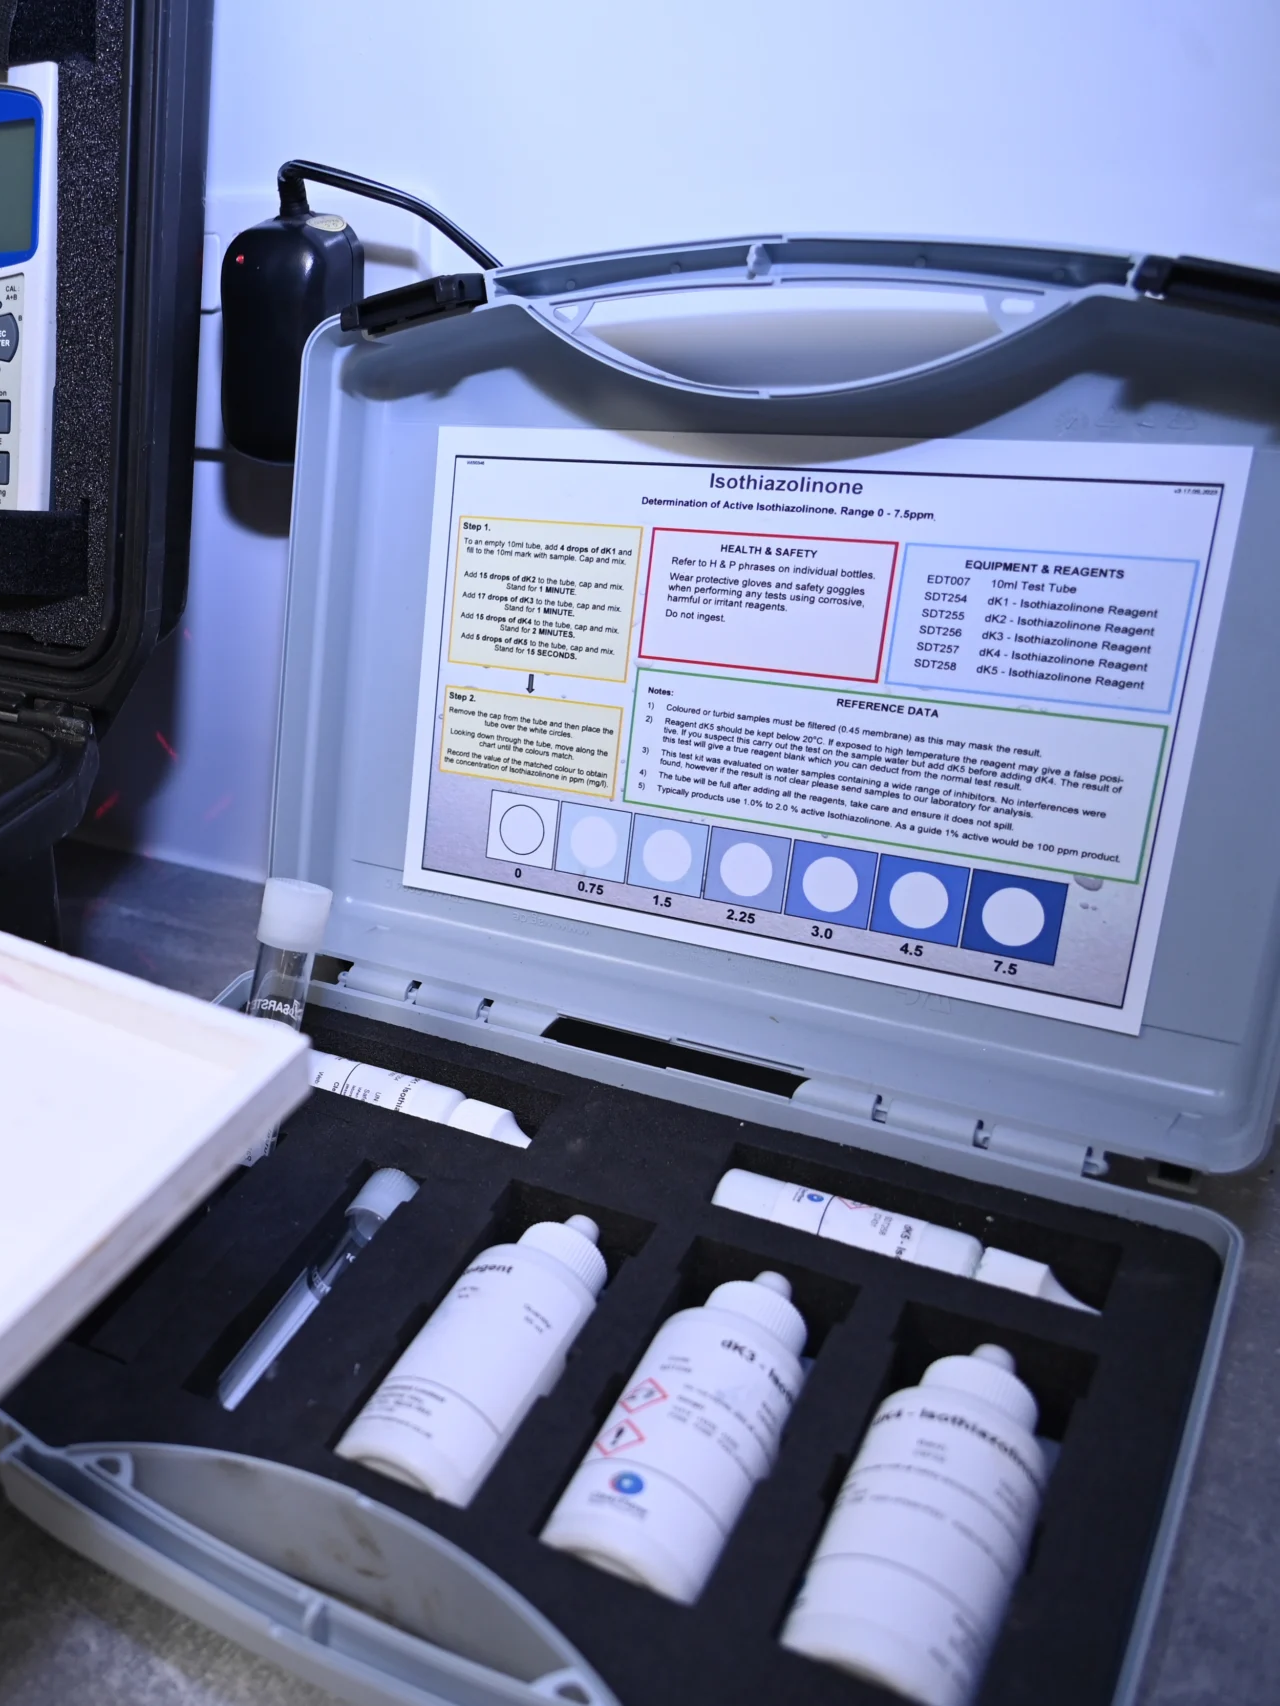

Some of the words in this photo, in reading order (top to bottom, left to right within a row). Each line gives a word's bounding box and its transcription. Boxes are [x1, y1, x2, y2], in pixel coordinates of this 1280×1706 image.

[709, 472, 863, 495] Isothiazolinone
[641, 496, 708, 508] Determination
[710, 499, 721, 508] of
[722, 500, 754, 510] Active
[756, 502, 836, 515] Isothiazolinone.
[840, 506, 875, 518] Range
[877, 508, 884, 517] 0
[894, 508, 935, 521] 7.5ppm.
[462, 521, 482, 532] Step
[484, 523, 490, 531] 1.
[720, 544, 762, 555] HEALTH
[764, 546, 772, 555] &
[774, 547, 818, 558] SAFETY
[671, 556, 696, 566] Refer
[698, 558, 707, 567] to
[709, 559, 717, 568] H
[719, 559, 726, 568] &
[728, 560, 736, 569] P
[738, 561, 775, 572] phrases
[792, 565, 838, 576] individual
[840, 568, 875, 579] bottles.
[964, 559, 1038, 573] EQUIPMENT
[1040, 564, 1050, 574] &
[1053, 565, 1124, 579] REAGENTS
[669, 572, 694, 582] Wear
[695, 575, 739, 586] protective
[741, 578, 772, 588] gloves
[774, 581, 793, 590] and
[794, 582, 824, 594] safety
[826, 585, 865, 596] goggles
[926, 574, 971, 586] EDT007
[991, 579, 1018, 590] 10ml
[1021, 580, 1045, 592] Test
[1048, 582, 1077, 594] Tube
[924, 591, 967, 603] SDT254
[987, 596, 1008, 606] dK1
[1020, 598, 1104, 614] Isothiazolinone
[1107, 605, 1158, 619] Reagent
[665, 608, 678, 618] Do
[680, 611, 694, 619] not
[696, 611, 725, 623] ingest.
[448, 691, 467, 702] Step
[468, 694, 476, 702] 2.
[647, 686, 674, 696] Notes:
[836, 698, 904, 714] REFERENCE
[907, 706, 938, 718] DATA
[666, 703, 701, 715] Coloured
[712, 709, 735, 719] turbid
[736, 713, 770, 724] samples
[772, 718, 793, 726] must
[794, 719, 805, 728] be
[807, 721, 836, 732] filtered
[837, 725, 860, 734] (0.45
[861, 729, 912, 743] membrane)
[927, 736, 944, 745] this
[946, 739, 966, 749] may
[968, 742, 993, 751] mask
[996, 744, 1011, 754] the
[1012, 747, 1041, 757] result.
[514, 868, 522, 879] 0
[577, 881, 604, 895] 0.75
[652, 895, 672, 908] 1.5
[726, 909, 756, 924] 2.25
[811, 925, 833, 940] 3.0
[899, 943, 924, 957] 4.5
[992, 960, 1018, 975] 7.5
[900, 1224, 913, 1240] dK5
[721, 1339, 756, 1363] dK3
